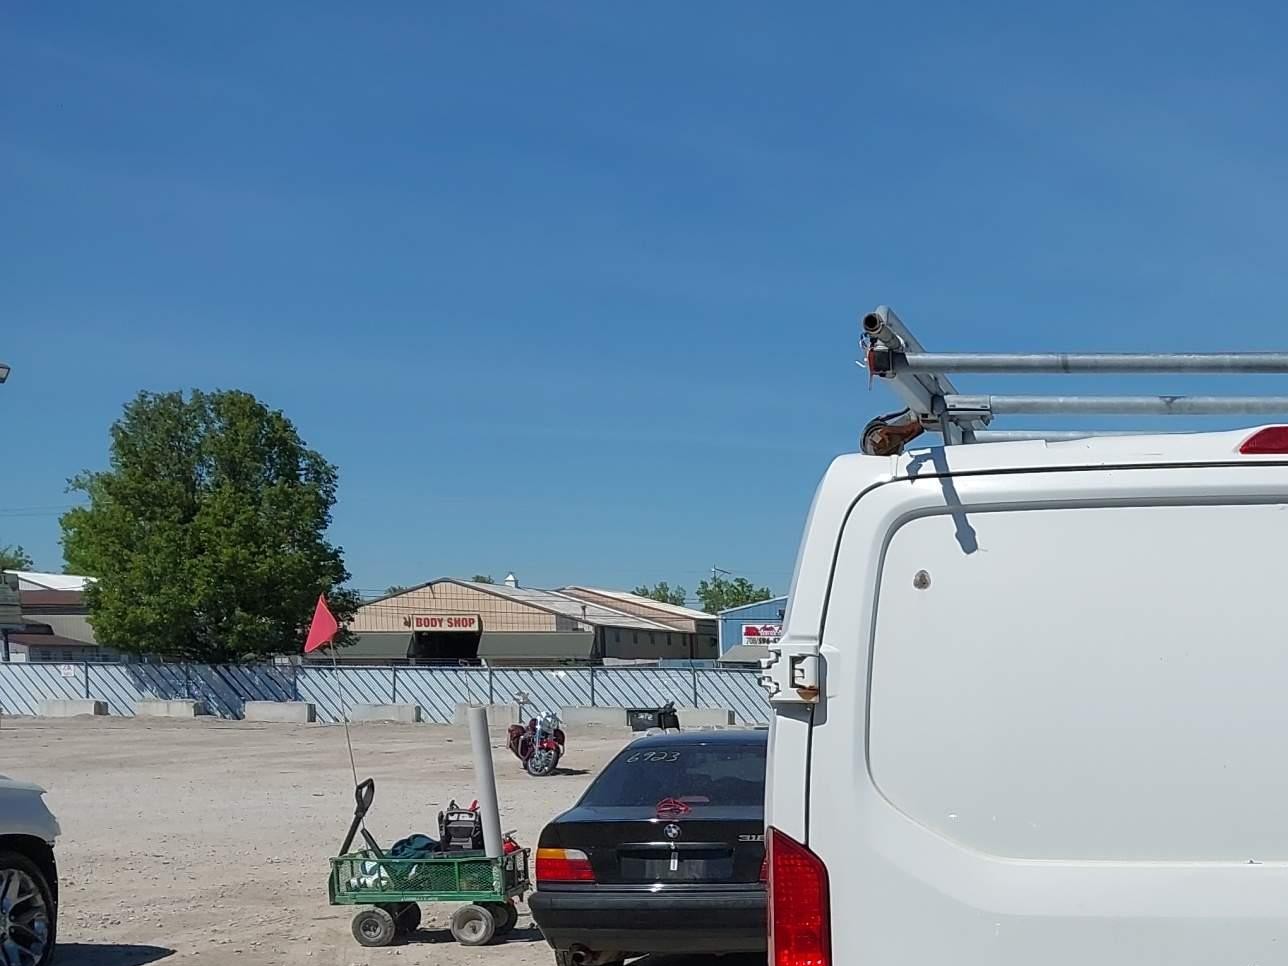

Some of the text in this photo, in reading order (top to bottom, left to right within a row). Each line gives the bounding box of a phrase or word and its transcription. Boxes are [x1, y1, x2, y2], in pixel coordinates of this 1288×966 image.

[415, 617, 475, 628] BODY SHOP
[627, 751, 681, 762] 6923
